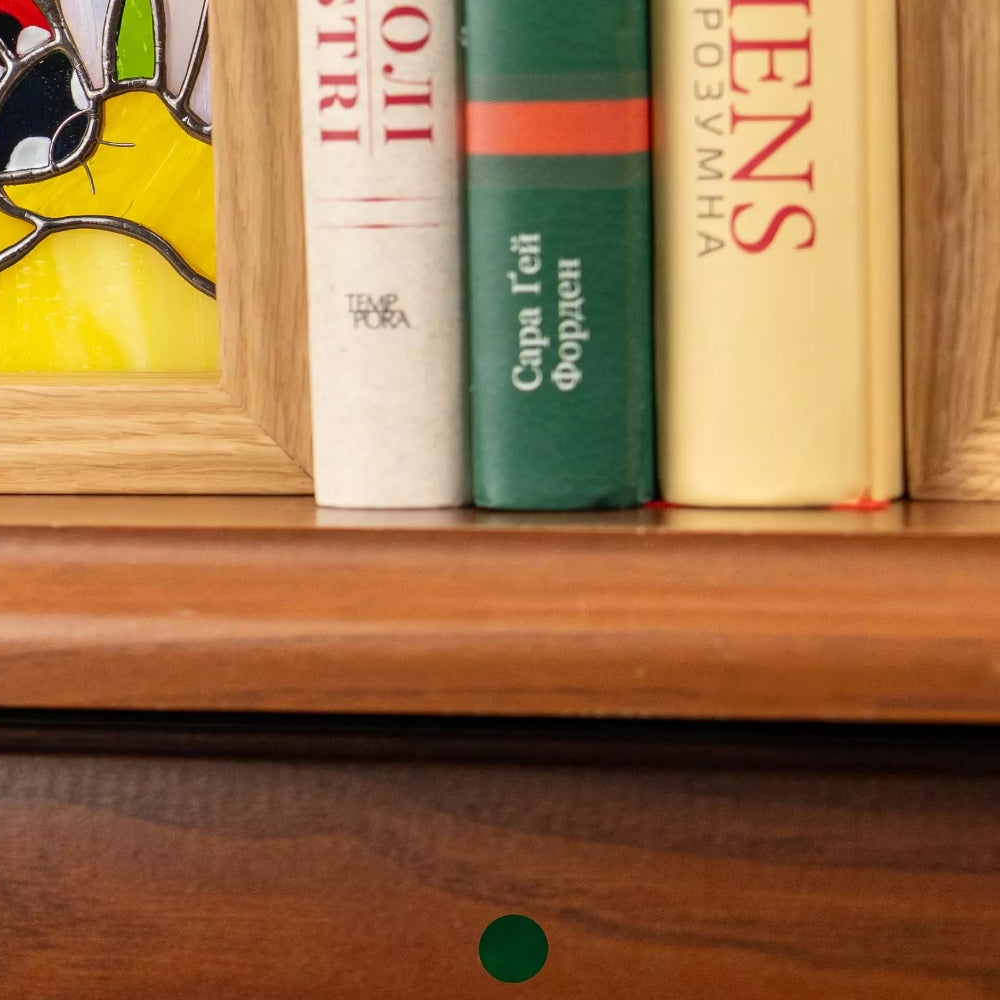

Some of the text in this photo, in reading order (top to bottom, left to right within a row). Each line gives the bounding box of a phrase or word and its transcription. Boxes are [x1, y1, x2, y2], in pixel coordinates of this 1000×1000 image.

[692, 7, 725, 259] РОЗУМНА
[506, 232, 550, 392] Сара Ґей
[550, 257, 590, 392] Форден
